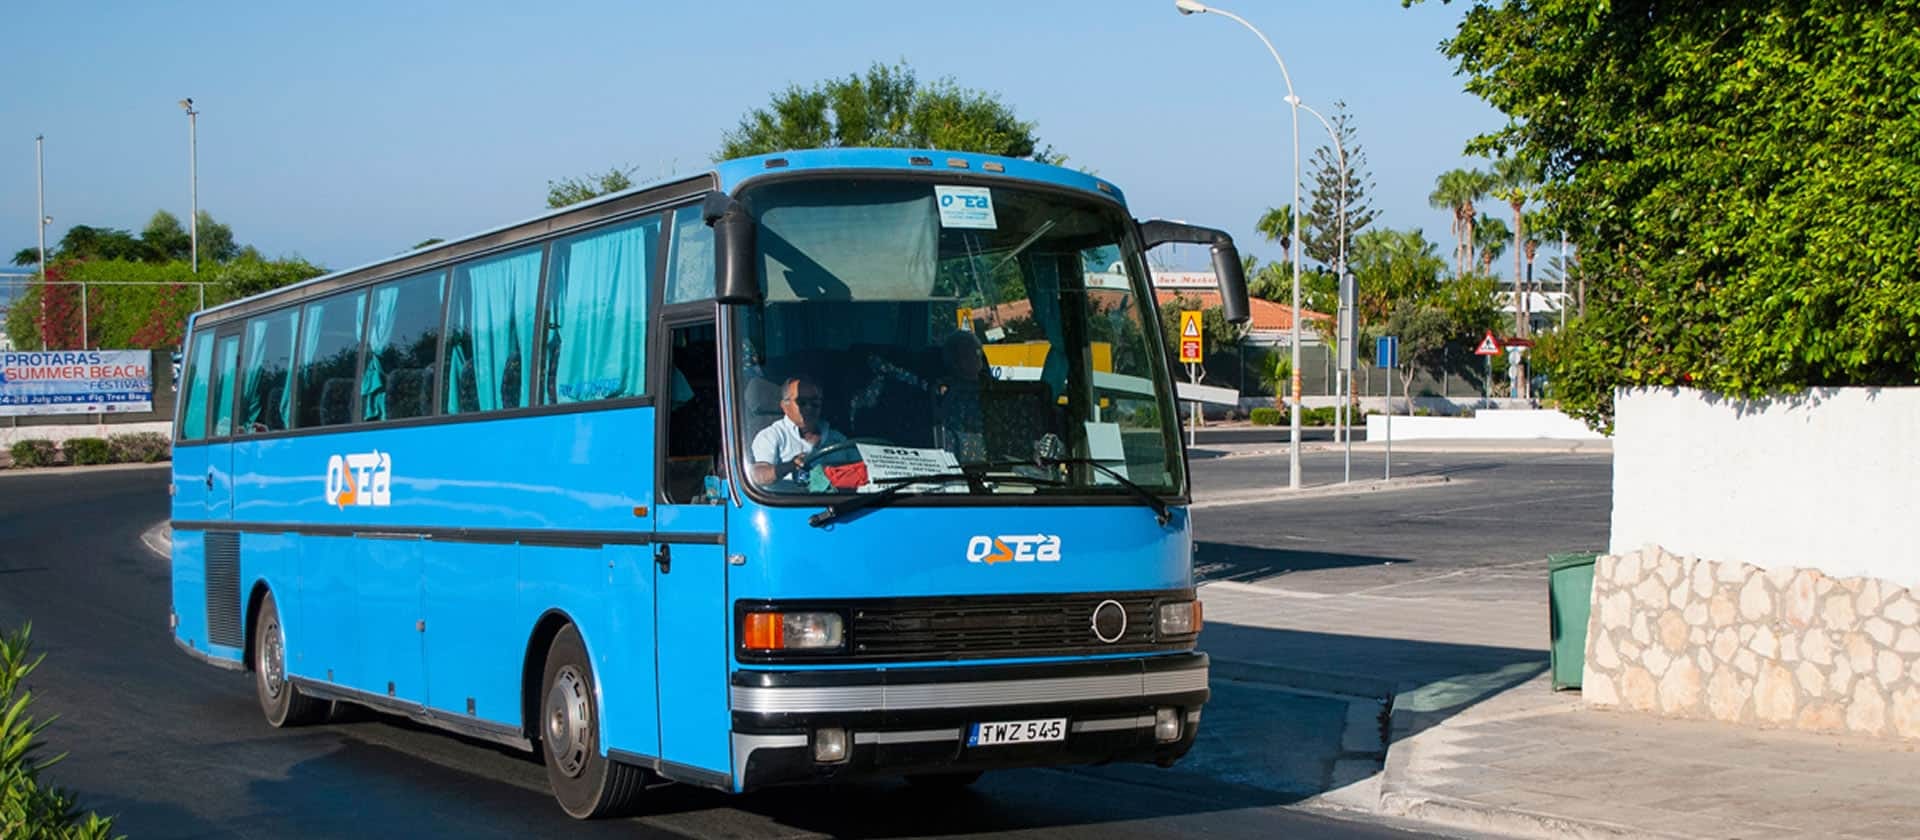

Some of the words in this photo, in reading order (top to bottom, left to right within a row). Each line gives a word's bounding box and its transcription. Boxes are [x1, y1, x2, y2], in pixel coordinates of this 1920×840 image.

[5, 353, 101, 366] PROTARAS
[6, 366, 84, 380] SUMMER
[90, 365, 145, 378] BEACH
[90, 380, 146, 389] FESTIVAL
[107, 393, 126, 401] Tree
[128, 392, 147, 401] Bay
[983, 723, 1022, 742] TWZ
[1027, 720, 1061, 739] 545
